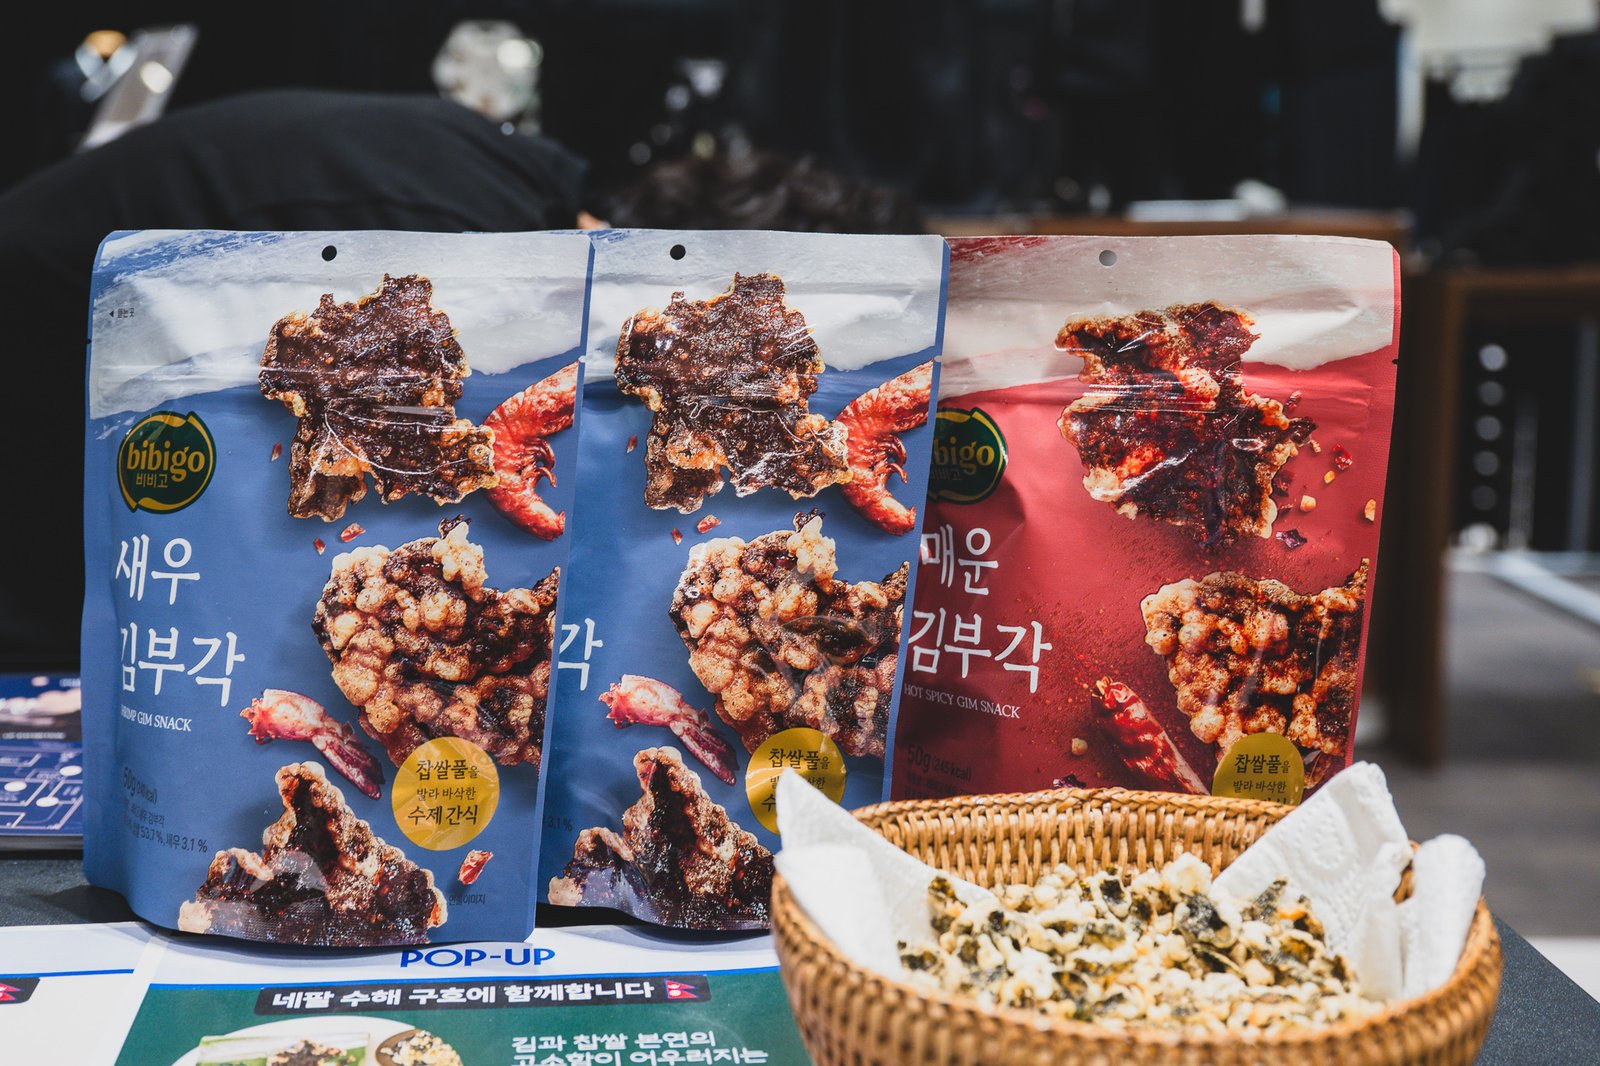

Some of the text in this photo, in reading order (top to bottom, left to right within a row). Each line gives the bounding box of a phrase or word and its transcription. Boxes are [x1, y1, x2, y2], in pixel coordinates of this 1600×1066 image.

[127, 439, 206, 482] bibigo
[932, 436, 995, 476] bigo
[136, 473, 169, 489] 비비고
[115, 533, 201, 606] 새우
[920, 524, 999, 596] 매운
[908, 607, 1053, 694] 김부각
[120, 622, 246, 707] 김부각
[904, 683, 1020, 719] HOT SPICY GIM SNACK
[137, 711, 152, 727] GIM
[154, 714, 193, 732] SNACK
[416, 759, 480, 781] 찹쌀풀을
[768, 748, 830, 770] 찹쌀풀을
[907, 745, 932, 774] 50g
[1234, 754, 1291, 774] 찹쌀풀을
[416, 787, 476, 801] 발라 바삭한
[1233, 780, 1287, 794] 발라 바삭한
[407, 805, 479, 825] 수제 간식
[400, 948, 556, 967] POP-UP
[272, 981, 655, 1009] 네팔 수해 구호에 함께합니다
[511, 1030, 716, 1053] 김과 찹쌀 본연의
[629, 1046, 769, 1066] 어우러지는
